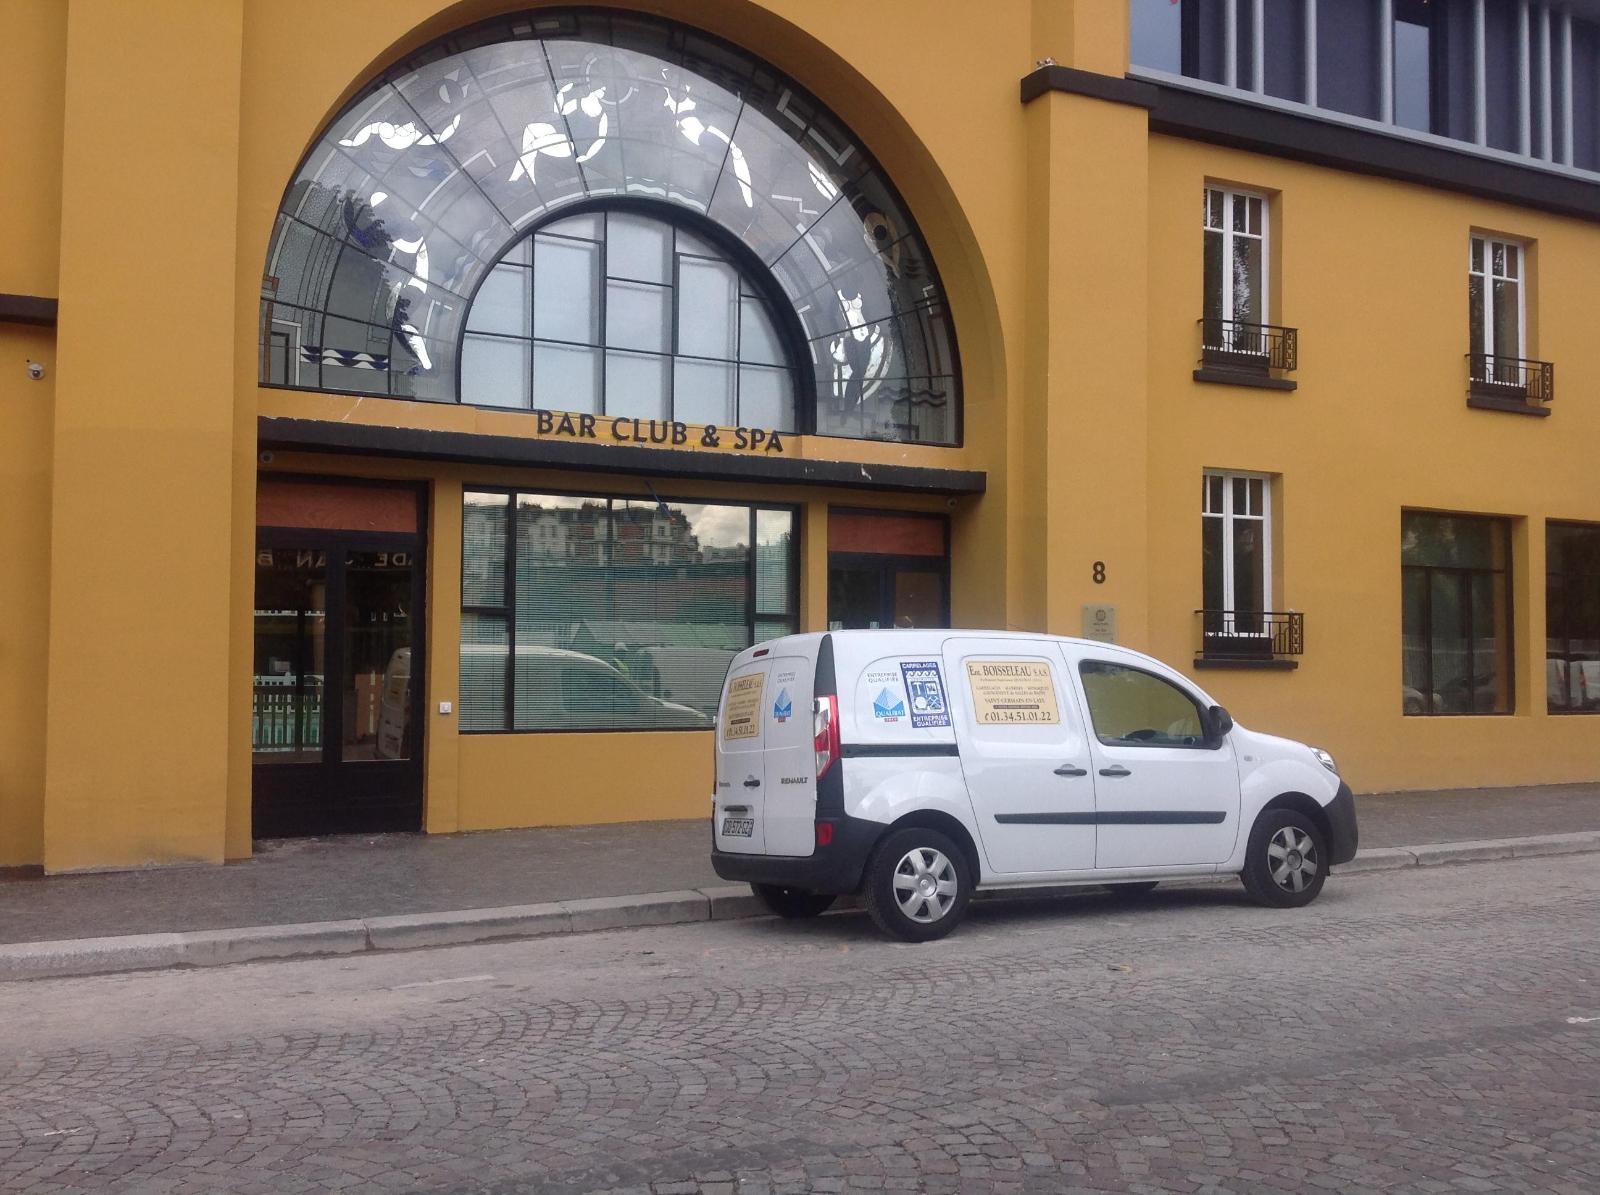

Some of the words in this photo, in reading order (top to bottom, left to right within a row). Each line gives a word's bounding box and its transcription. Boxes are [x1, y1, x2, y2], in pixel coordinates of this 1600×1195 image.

[537, 411, 596, 438] BAR
[611, 417, 688, 445] CLUB
[701, 424, 720, 447] &
[734, 427, 784, 452] SPA
[1092, 560, 1106, 585] 8
[983, 665, 1032, 677] BOISSELEAU
[990, 711, 1052, 722] 01.34.51.01.22
[780, 777, 809, 785] RENAULT
